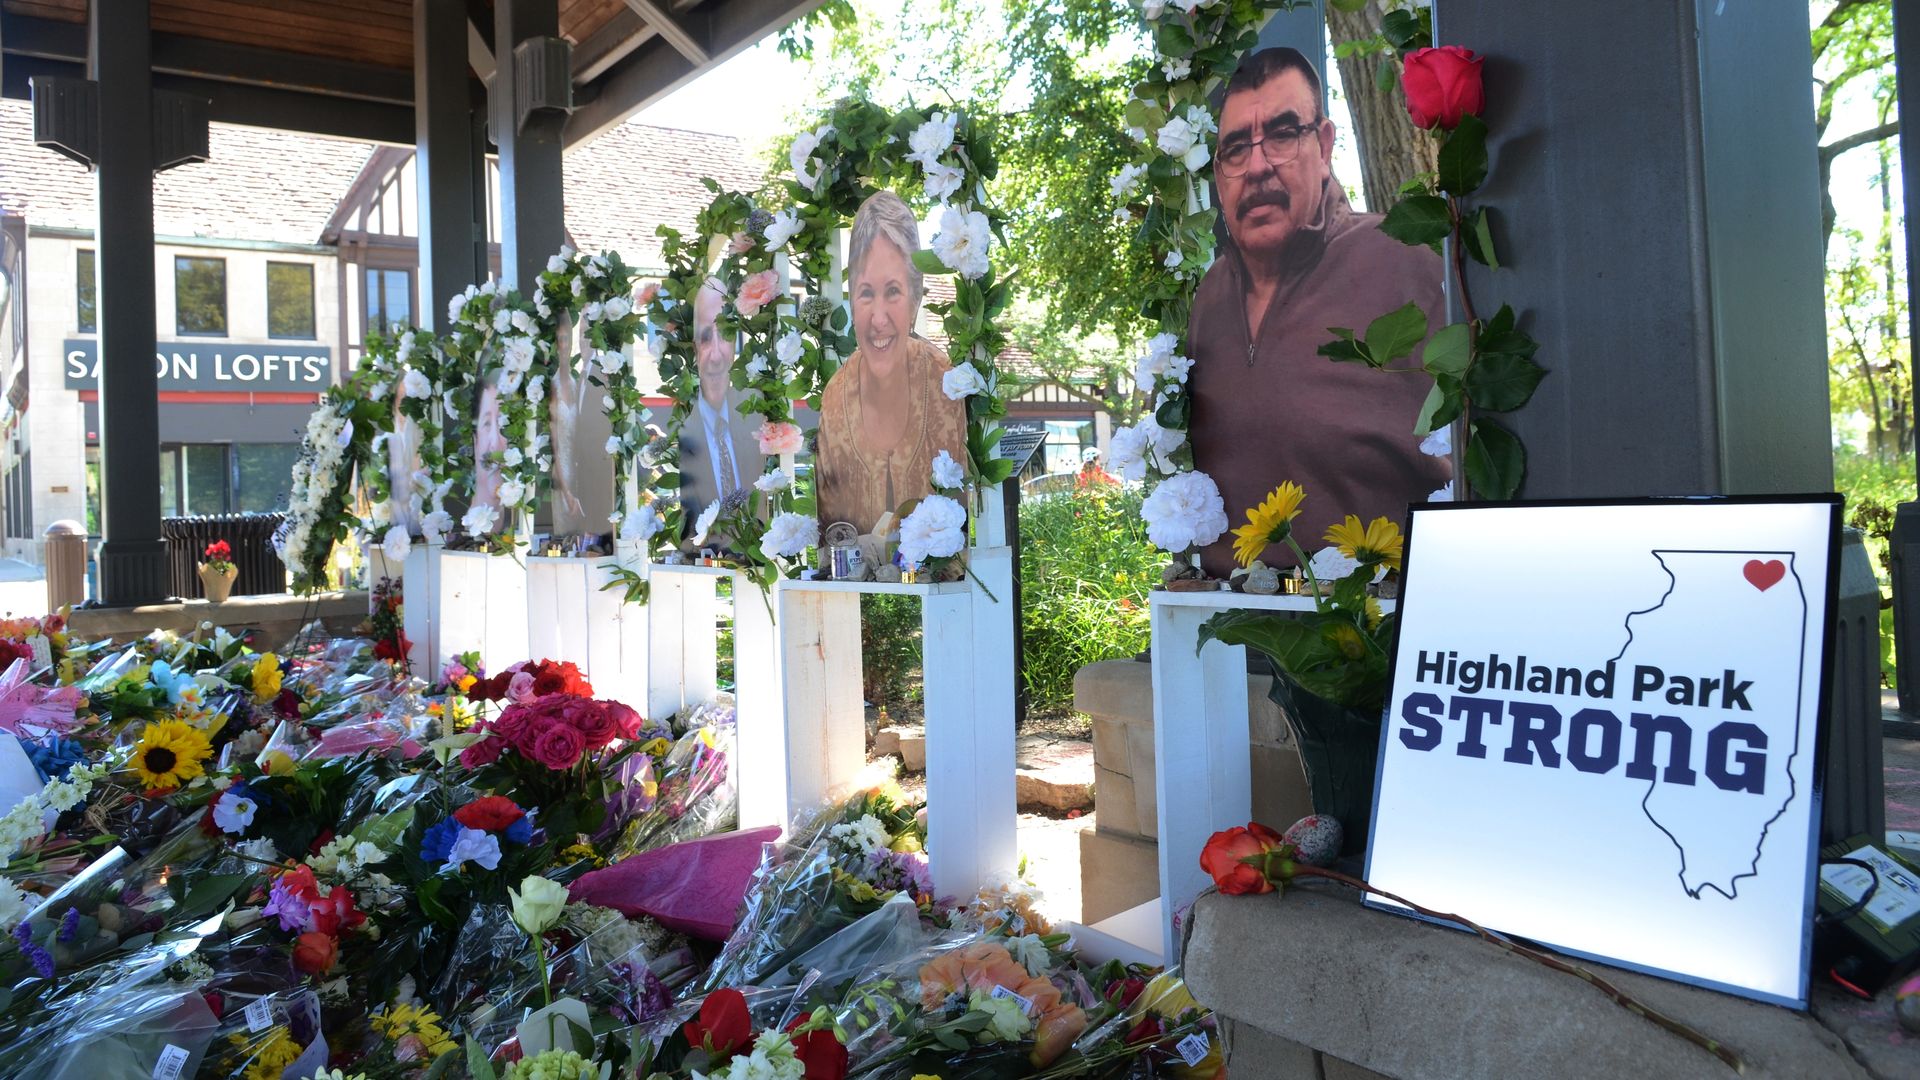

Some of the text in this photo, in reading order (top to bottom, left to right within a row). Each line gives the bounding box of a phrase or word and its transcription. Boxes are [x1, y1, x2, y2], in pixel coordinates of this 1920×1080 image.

[67, 350, 322, 382] SON LOFTS
[1415, 650, 1755, 712] Highland Park
[1399, 691, 1769, 796] STRONG
